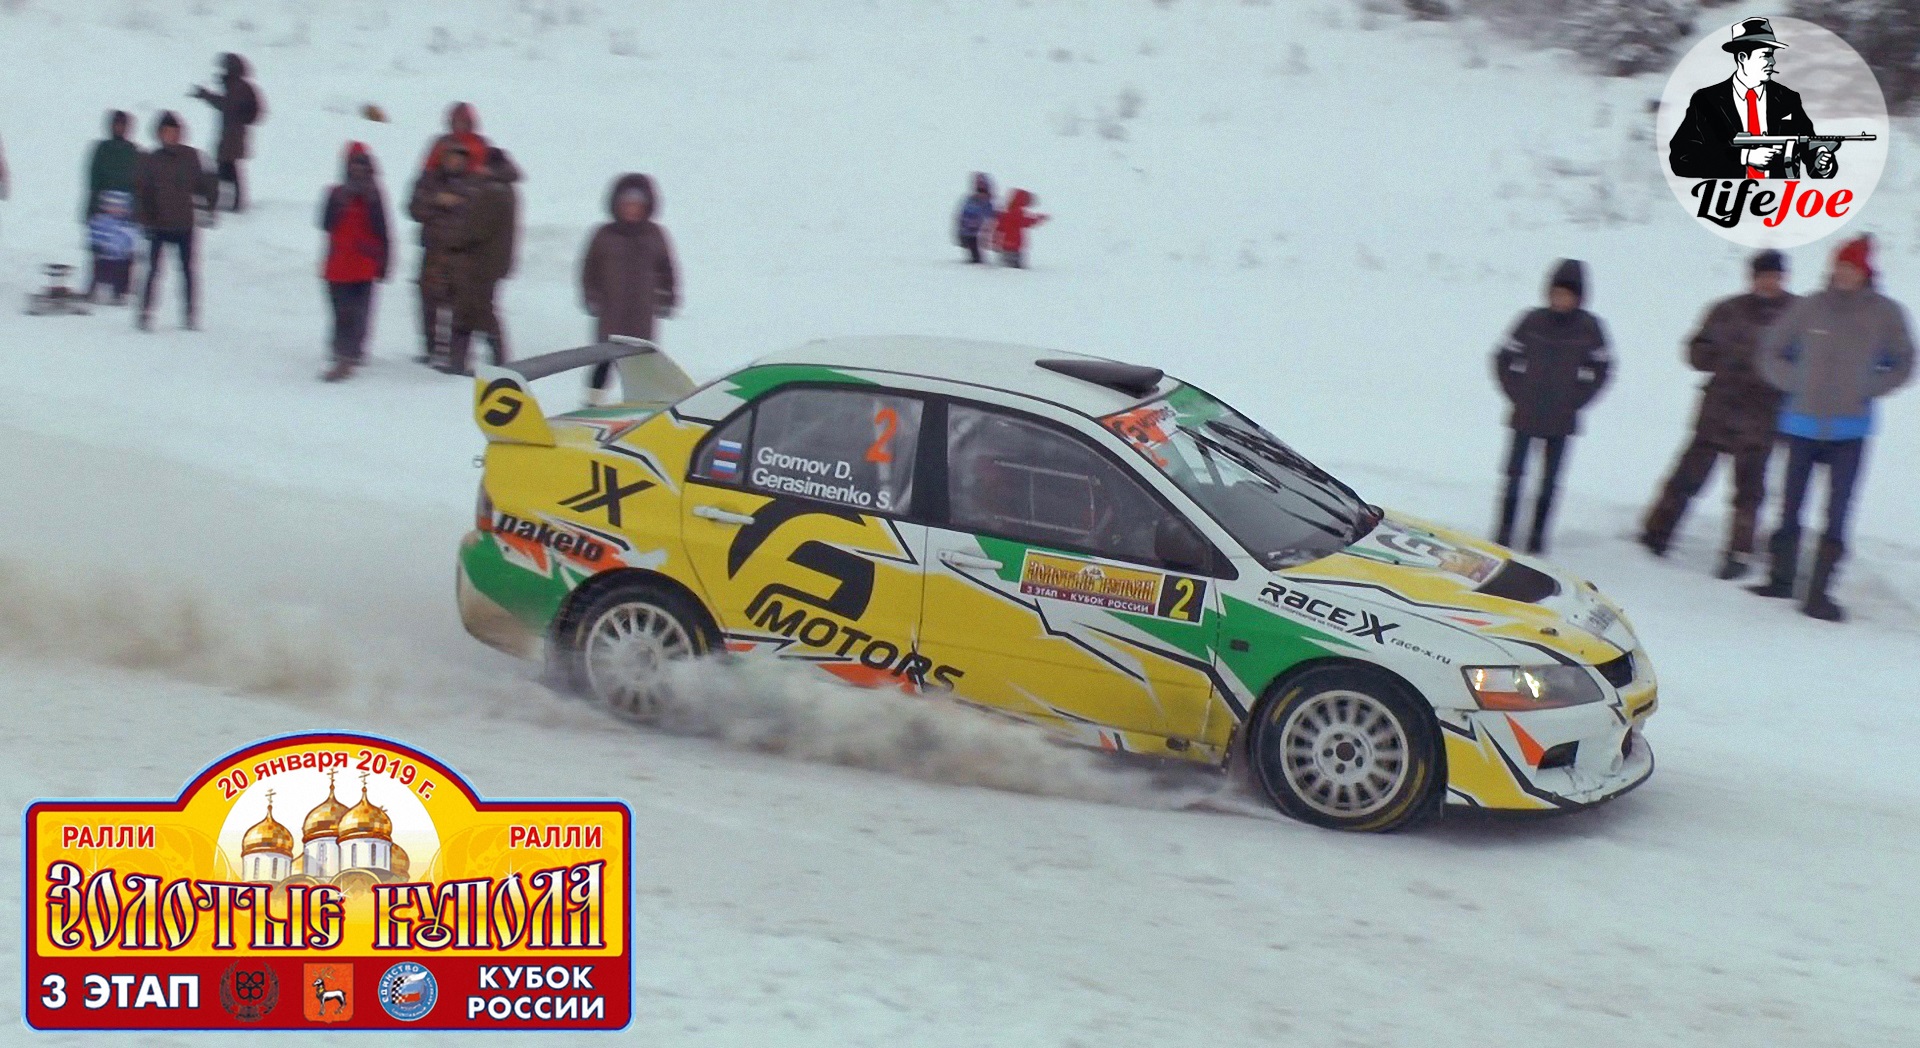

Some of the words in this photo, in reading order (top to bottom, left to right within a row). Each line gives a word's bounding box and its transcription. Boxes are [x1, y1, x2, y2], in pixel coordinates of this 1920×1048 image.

[865, 408, 897, 463] 2
[757, 446, 831, 476] Gromov
[834, 460, 853, 481] D.
[752, 467, 871, 506] Gerasimenko
[875, 490, 894, 511] S.
[1070, 591, 1104, 606] КУБОК
[1107, 598, 1149, 614] РОССИИ
[1169, 578, 1195, 621] 2
[754, 600, 965, 692] MOTORS
[1389, 636, 1452, 666] race-x.ru
